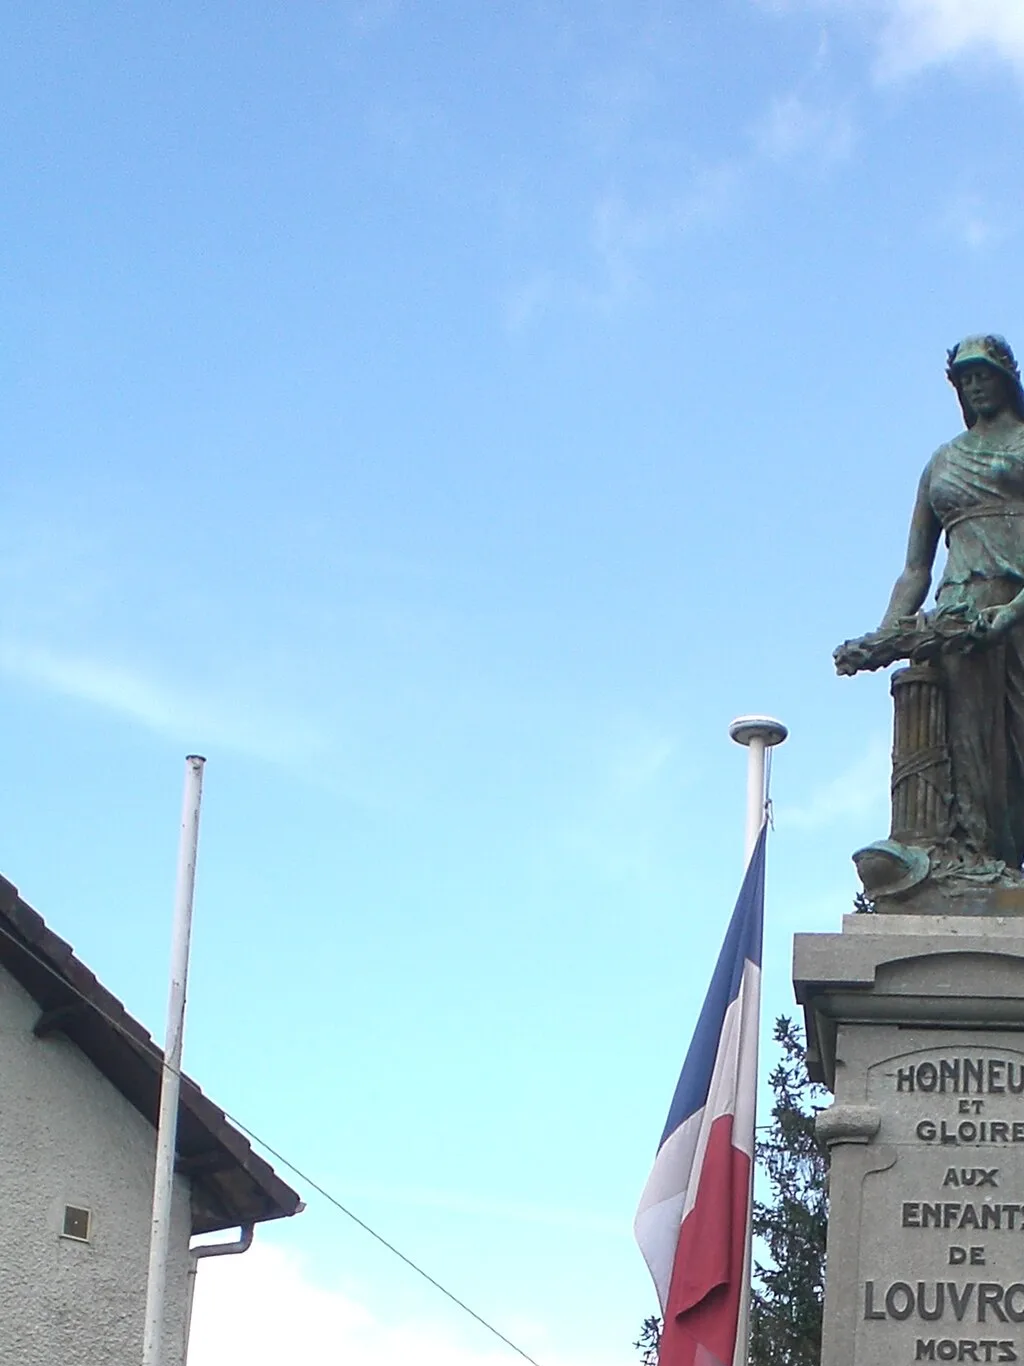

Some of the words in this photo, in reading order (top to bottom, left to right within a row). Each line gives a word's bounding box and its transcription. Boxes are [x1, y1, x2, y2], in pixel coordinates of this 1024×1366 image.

[959, 1099, 985, 1115] ET
[943, 1167, 999, 1188] AUX
[949, 1246, 986, 1265] DE
[915, 1339, 1017, 1362] MORTS
